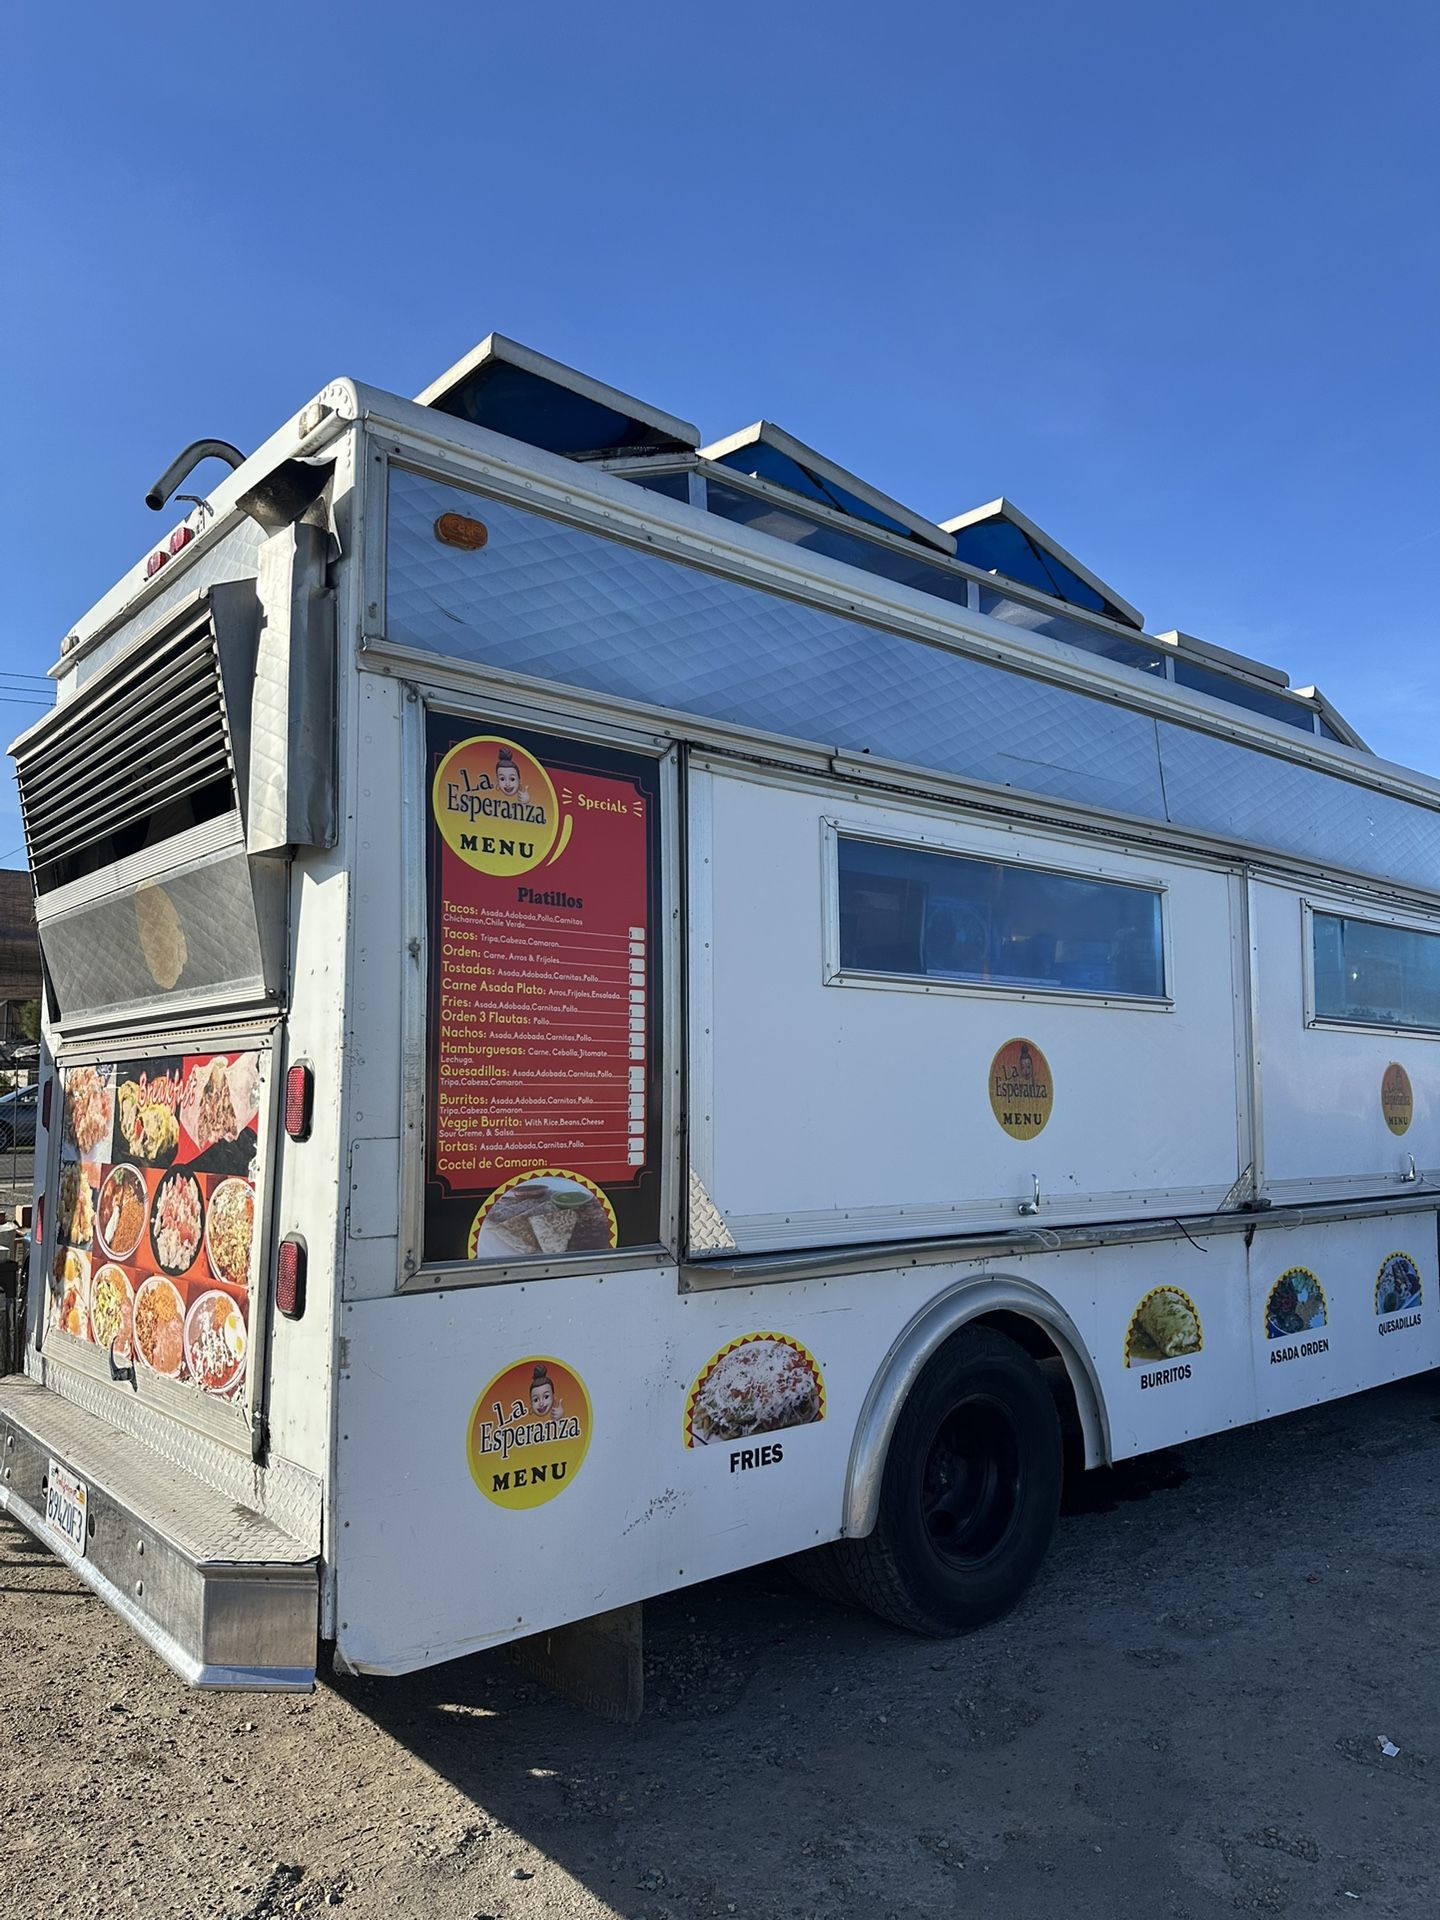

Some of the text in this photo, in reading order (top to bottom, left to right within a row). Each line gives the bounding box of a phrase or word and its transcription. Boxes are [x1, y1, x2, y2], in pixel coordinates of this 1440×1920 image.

[460, 768, 494, 792] La
[447, 783, 547, 824] Esperanza
[577, 794, 628, 814] Specials
[460, 834, 534, 858] MENU
[517, 887, 584, 909] Platillos
[443, 901, 478, 916] Tacos:
[506, 920, 526, 929] Verde
[443, 927, 478, 941] Tacos:
[443, 944, 481, 958] Orden:
[528, 954, 535, 962] &
[536, 955, 560, 967] Frijoles
[443, 961, 495, 976] Tostadas:
[442, 978, 477, 991] Carne
[480, 981, 514, 994] Asada
[516, 982, 546, 996] Plato:
[442, 995, 471, 1008] Fries:
[442, 1009, 550, 1026] Orden 3 Flautas: Pollo
[441, 1026, 487, 1039] Nachos:
[441, 1042, 526, 1058] Hamburguesas:
[440, 1065, 510, 1078] Quesadillas:
[1002, 1065, 1019, 1081] La
[138, 1068, 197, 1114] Breakfast
[995, 1077, 1047, 1103] Esperanza
[440, 1093, 488, 1106] Burritos:
[440, 1117, 478, 1131] Veggie
[481, 1116, 523, 1128] Burrito:
[524, 1118, 543, 1128] With
[1003, 1113, 1042, 1125] MENU
[439, 1129, 457, 1138] Sour
[486, 1128, 493, 1137] &
[494, 1128, 514, 1137] Salsa
[439, 1140, 477, 1152] Tortas:
[438, 1155, 548, 1170] Coctel de Camaron:
[1378, 1313, 1422, 1337] QUESADILLAS
[1270, 1338, 1329, 1365] ASADA ORDEN
[1140, 1364, 1192, 1390] BURRITOS
[492, 1399, 527, 1427] La
[479, 1415, 581, 1459] Esperanza
[729, 1443, 784, 1473] FRIES
[492, 1461, 568, 1493] MENU
